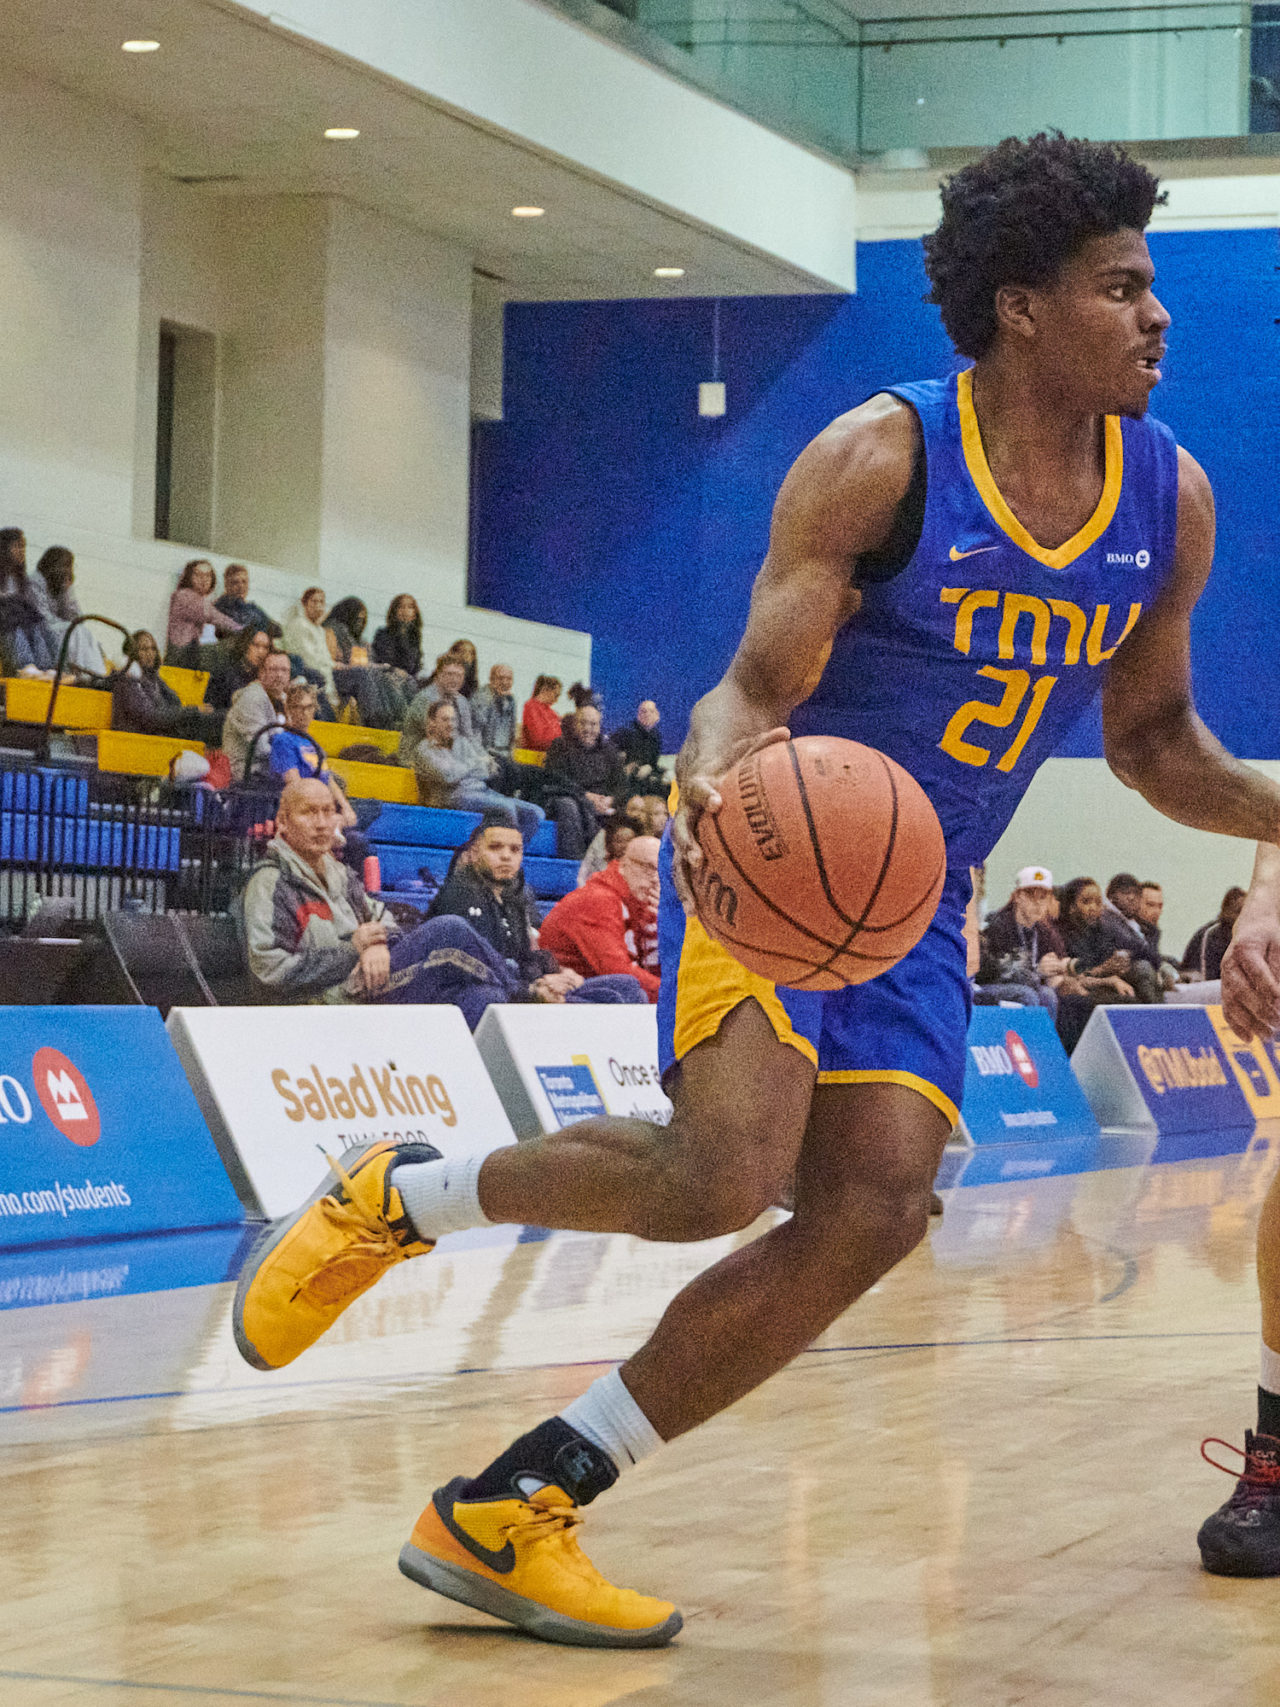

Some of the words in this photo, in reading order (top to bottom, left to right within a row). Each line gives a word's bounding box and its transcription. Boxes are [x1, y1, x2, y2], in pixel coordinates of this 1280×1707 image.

[1106, 553, 1134, 564] BMO
[939, 587, 1143, 666] TMU
[936, 665, 1059, 773] 21
[608, 1056, 653, 1087] Once
[970, 1044, 1014, 1077] BMO
[0, 1074, 33, 1124] O
[271, 1063, 378, 1123] Salad
[368, 1065, 458, 1128] King
